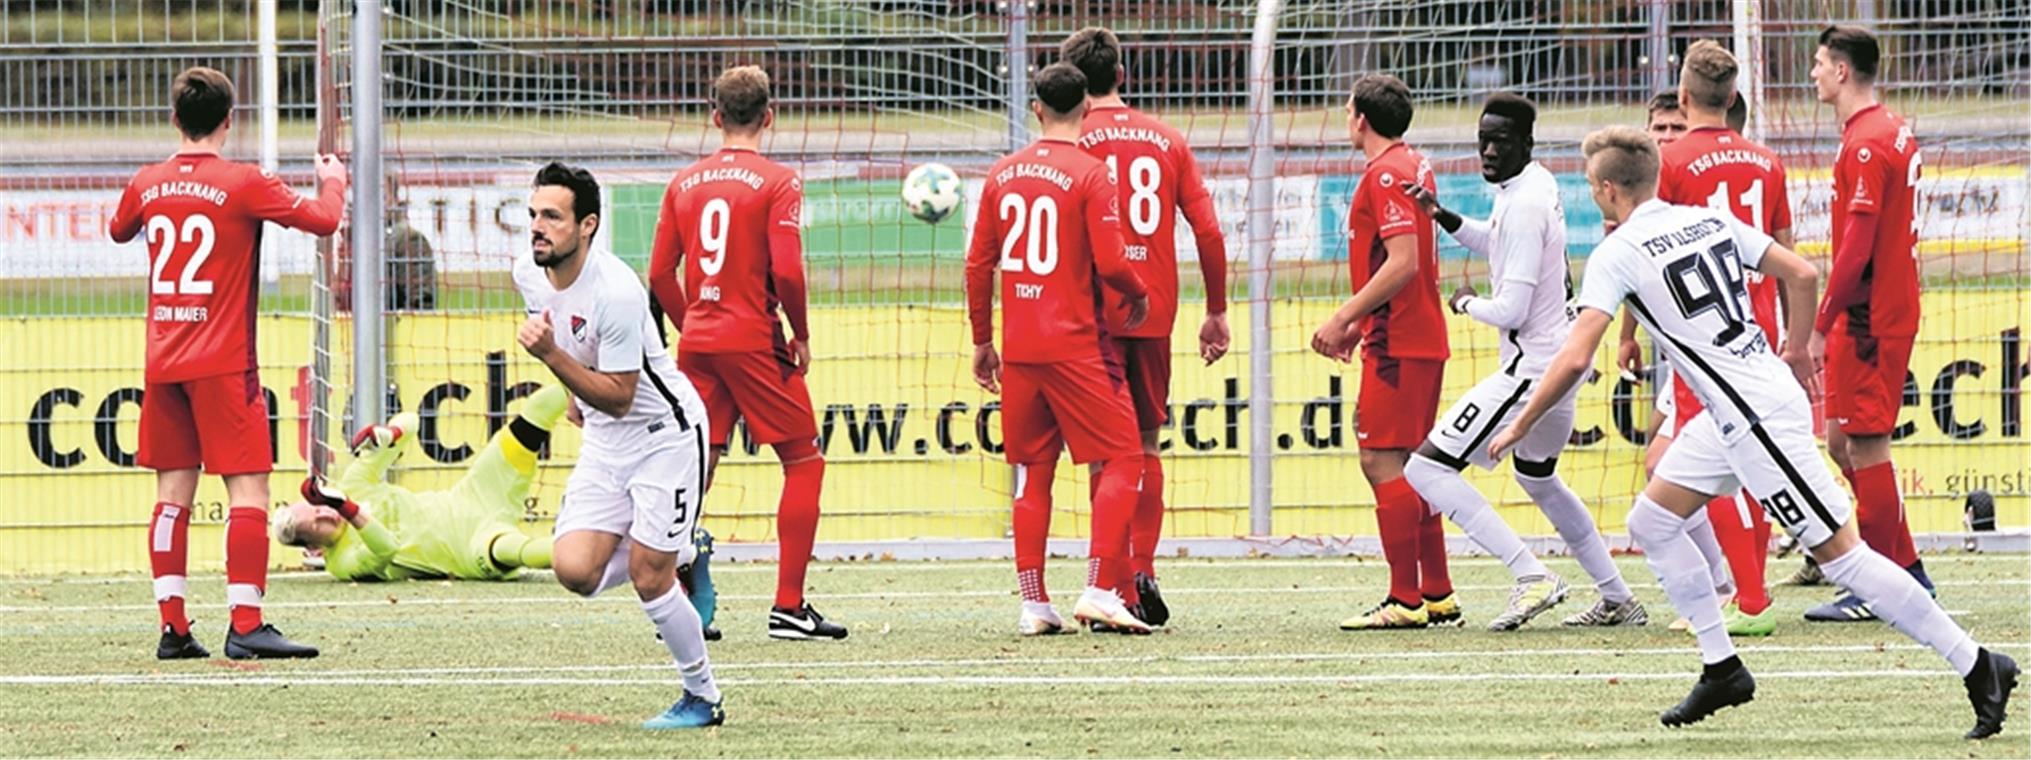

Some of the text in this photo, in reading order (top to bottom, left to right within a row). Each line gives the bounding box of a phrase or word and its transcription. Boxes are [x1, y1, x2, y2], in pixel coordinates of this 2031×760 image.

[1080, 126, 1170, 153] TSG BACKNANG
[996, 163, 1073, 192] TSG BACKNANG
[1687, 149, 1772, 176] TSG BACKNANG
[161, 181, 228, 206] BACKNANG
[680, 168, 765, 193] TSG BACKNANG
[699, 198, 731, 277] 9
[1000, 193, 1059, 276] 20
[1641, 234, 1674, 257] TSV
[148, 214, 216, 295] 22
[1662, 238, 1754, 347] 98
[1453, 402, 1480, 434] 8
[673, 487, 688, 525] 5
